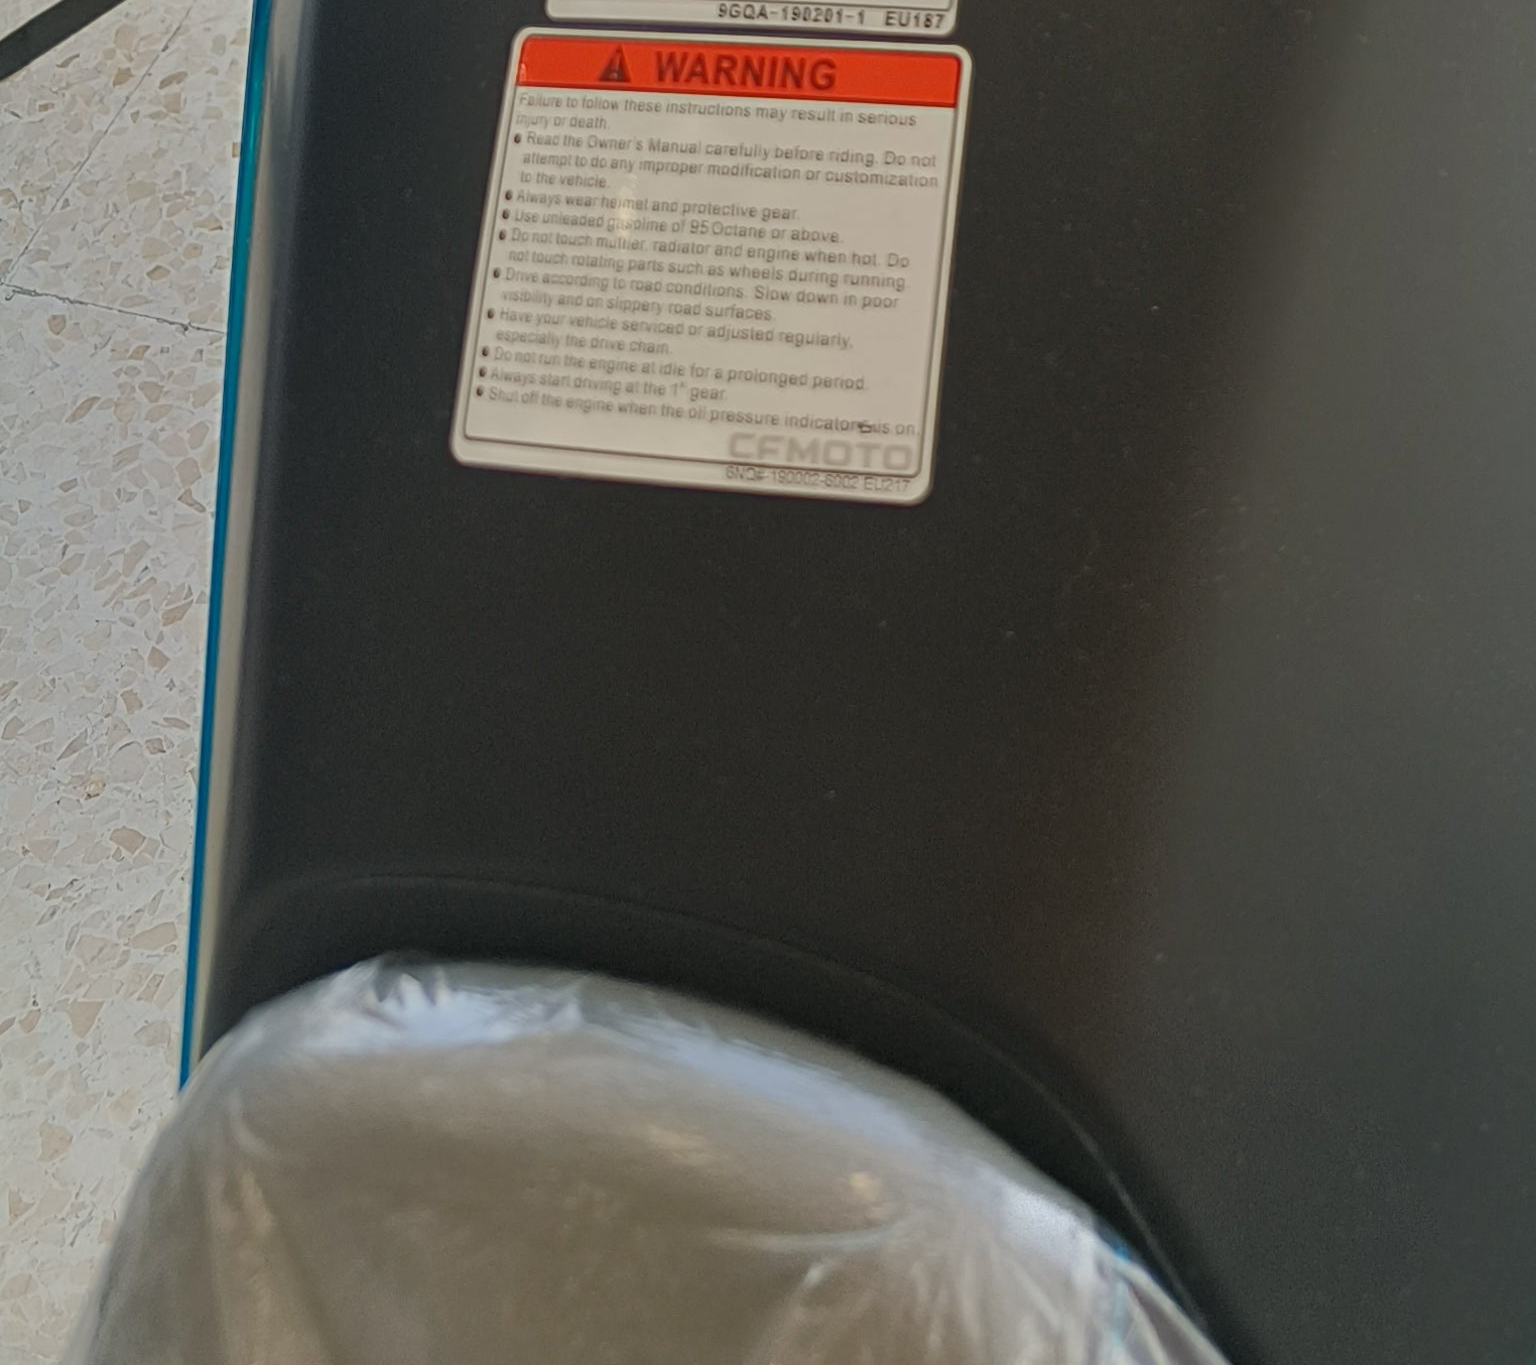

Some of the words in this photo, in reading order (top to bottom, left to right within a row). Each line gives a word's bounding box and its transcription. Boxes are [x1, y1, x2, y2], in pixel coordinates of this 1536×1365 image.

[653, 50, 838, 92] WARNING
[553, 118, 566, 126] or
[566, 95, 579, 106] to
[582, 95, 620, 109] follow
[624, 98, 662, 111] these
[666, 100, 751, 116] instructions
[755, 107, 786, 119] may
[792, 106, 836, 120] result
[840, 109, 854, 121] in
[858, 110, 917, 124] serious
[526, 132, 560, 145] Read
[563, 134, 583, 147] the
[586, 135, 643, 150] Owner's
[648, 139, 701, 153] Manual
[705, 142, 770, 159] carefully
[774, 146, 824, 161] before
[882, 152, 906, 165] Do
[911, 154, 937, 167] not
[520, 172, 532, 182] to
[536, 173, 556, 184] the
[523, 152, 573, 167] attempt
[575, 155, 588, 166] to
[590, 156, 607, 168] do
[610, 160, 634, 171] any
[639, 159, 703, 175] improper
[707, 163, 801, 179] modification
[806, 171, 820, 180] or
[825, 169, 938, 187] customization
[516, 191, 562, 206] Always
[565, 197, 597, 206] wear
[652, 199, 679, 212] and
[682, 201, 757, 218] protective
[514, 209, 539, 222] Use
[543, 210, 605, 226] unleaded
[671, 219, 687, 232] of
[689, 220, 710, 233] 95
[710, 221, 767, 237] Octane
[771, 228, 786, 238] or
[790, 227, 843, 242] above.
[511, 228, 530, 241] Do
[532, 230, 554, 243] not
[555, 231, 593, 246] touch
[653, 238, 710, 254] radiator
[714, 242, 743, 256] and
[746, 244, 800, 262] engine
[804, 248, 847, 263] when
[886, 254, 909, 267] Do
[509, 249, 531, 262] not
[531, 250, 568, 264] touch
[571, 253, 625, 270] rotating
[628, 257, 664, 273] parts
[668, 260, 704, 274] such
[707, 266, 724, 275] as
[729, 264, 783, 280] wheels
[788, 268, 839, 285] during
[505, 269, 539, 282] Drive
[542, 271, 609, 289] according
[613, 276, 626, 288] to
[630, 278, 663, 291] road
[754, 287, 791, 300] Slow
[796, 290, 838, 304] down
[843, 293, 857, 305] in
[861, 297, 898, 310] poor
[557, 293, 584, 306] and
[586, 298, 603, 307] on
[668, 301, 702, 315] road
[495, 329, 561, 346] especially
[565, 334, 587, 346] the
[590, 336, 626, 349] drive
[629, 339, 673, 353] chain.
[499, 309, 533, 322] Have
[536, 315, 565, 326] your
[569, 314, 618, 329] vehicle
[622, 318, 684, 334] serviced
[688, 327, 703, 335] or
[707, 325, 774, 343] adjusted
[778, 330, 853, 349] regularly,
[490, 368, 537, 385] Always
[539, 372, 572, 386] start
[626, 379, 641, 392] at
[643, 381, 666, 394] the
[493, 348, 512, 361] Do
[514, 350, 537, 363] not
[539, 355, 561, 365] run
[563, 354, 586, 367] the
[588, 356, 638, 373] engine
[642, 360, 657, 372] at
[659, 361, 686, 375] idle
[690, 364, 710, 377] for
[714, 369, 723, 378] a
[727, 367, 808, 387] prolonged
[488, 388, 521, 402] Shut
[521, 390, 540, 404] off
[541, 392, 563, 406] the
[565, 394, 614, 412] engine
[618, 399, 657, 414] when
[661, 402, 684, 417] the
[688, 405, 707, 419] oil
[710, 410, 779, 427] pressure
[728, 431, 914, 471] CFMOTO
